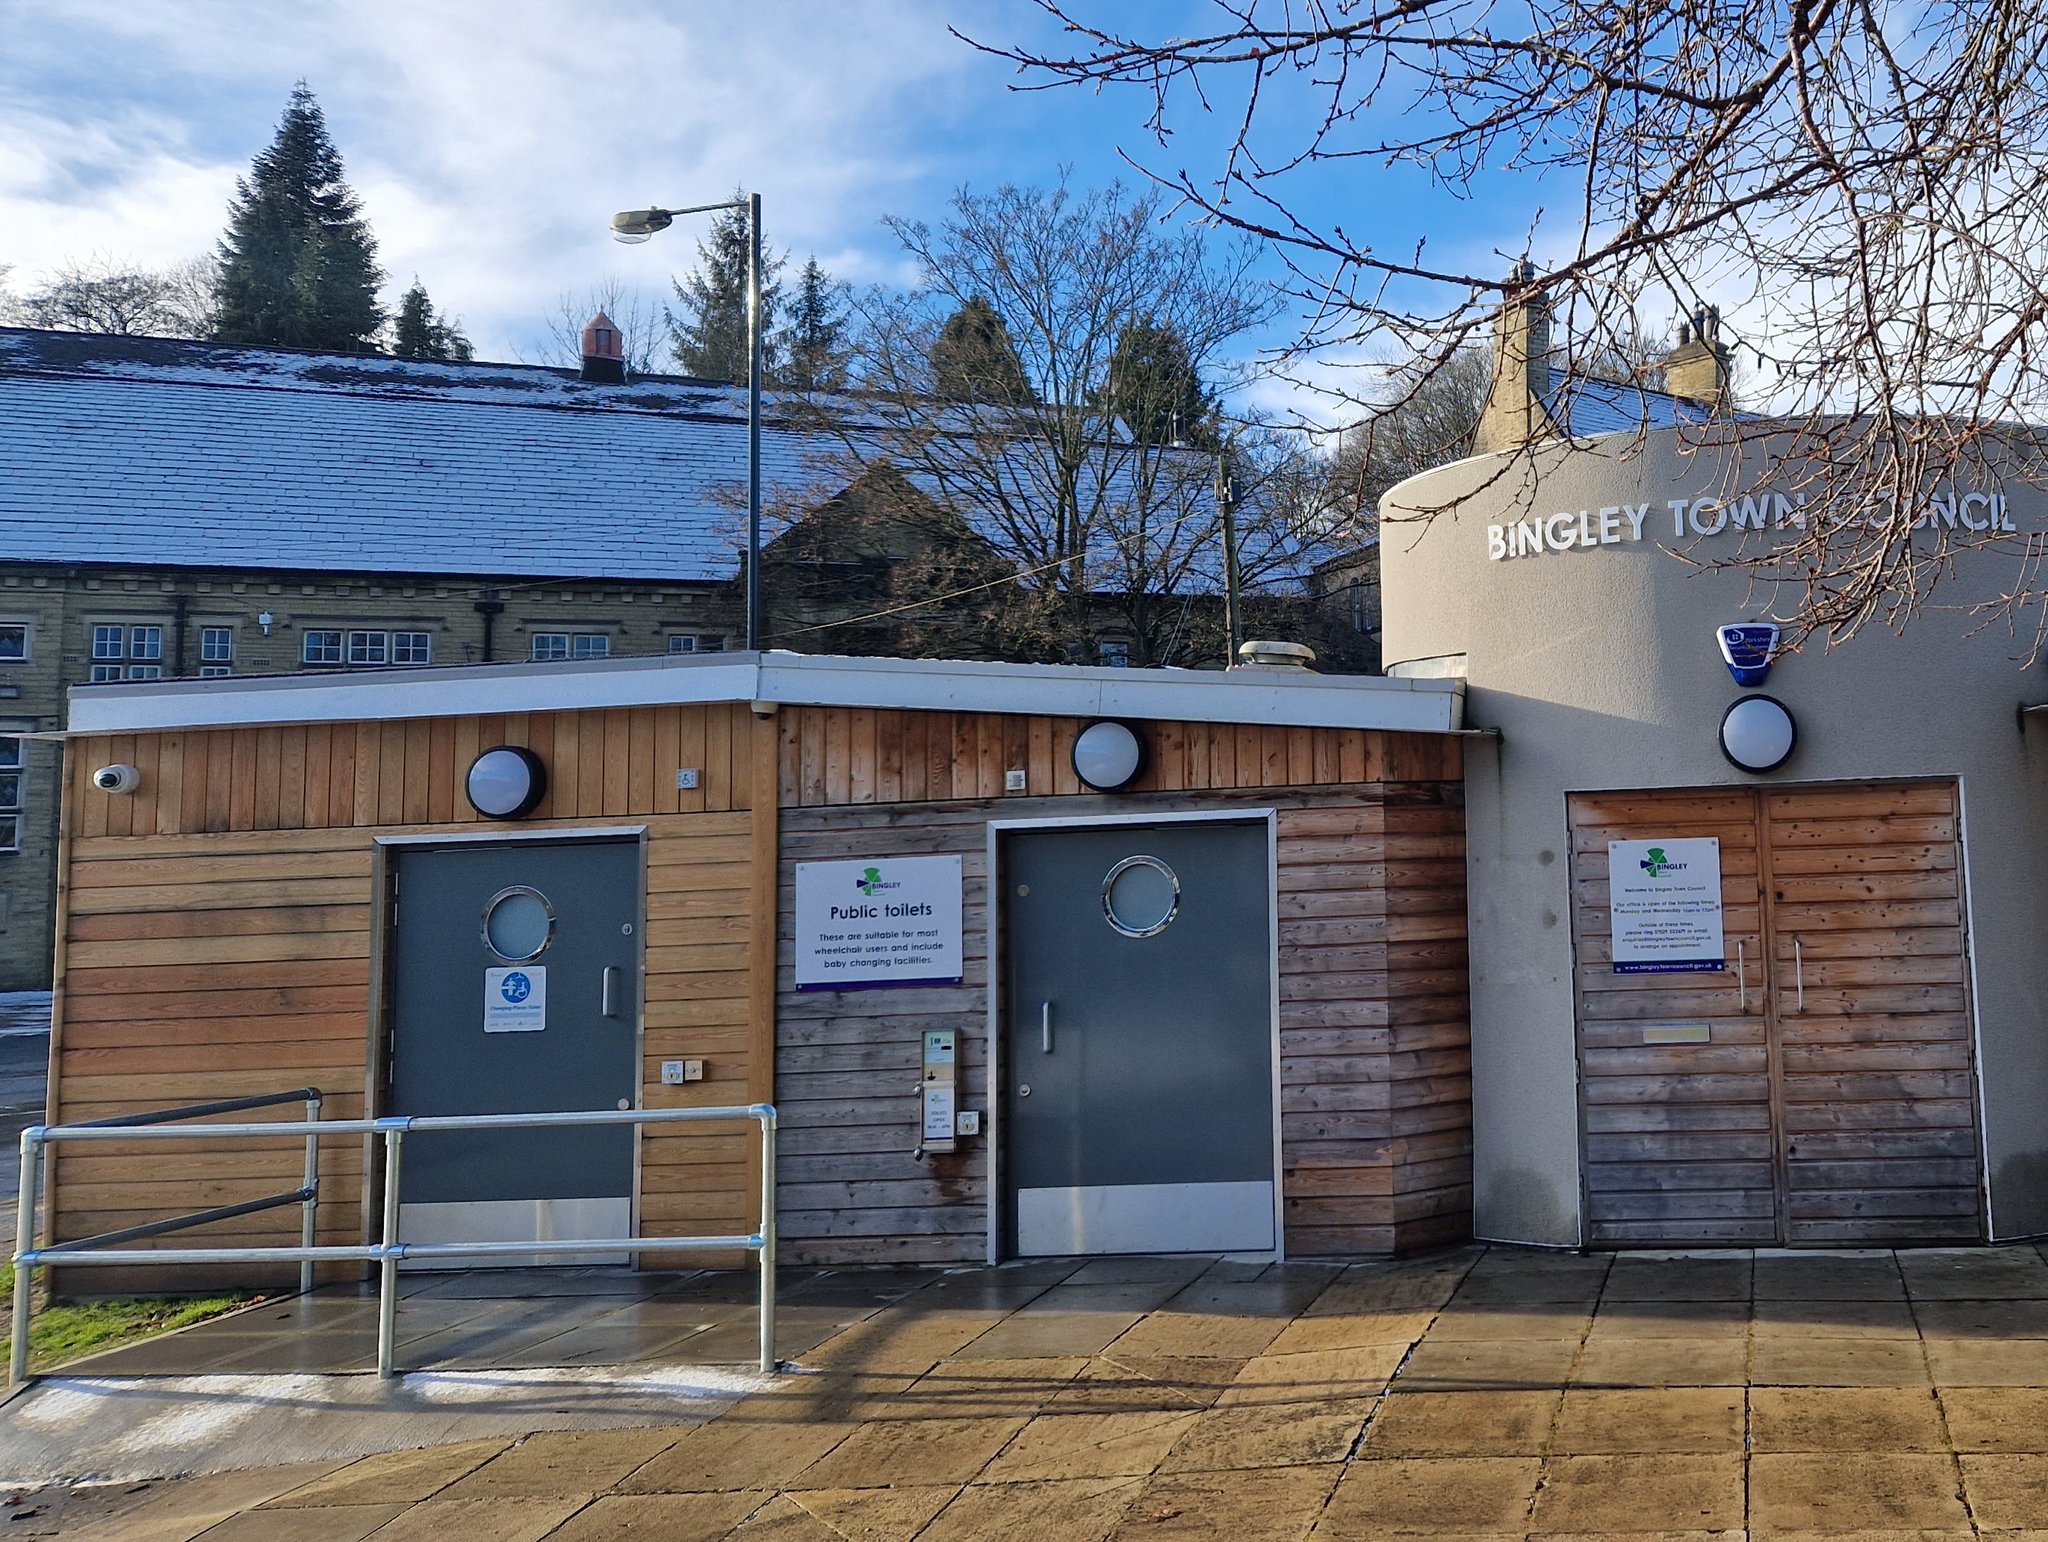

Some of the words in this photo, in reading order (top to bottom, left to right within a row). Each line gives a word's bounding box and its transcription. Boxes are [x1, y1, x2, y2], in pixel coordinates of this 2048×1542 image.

[1487, 503, 1649, 560] BINGLEY
[1668, 492, 1807, 537] TOWN
[872, 882, 901, 890] BINGLEY
[830, 905, 878, 920] Public
[885, 903, 932, 917] toilets
[819, 933, 844, 941] These
[865, 931, 899, 940] suitable
[814, 946, 862, 955] wheelchair
[891, 943, 908, 952] and
[911, 942, 944, 950] include
[824, 959, 846, 969] baby
[850, 958, 891, 967] changing
